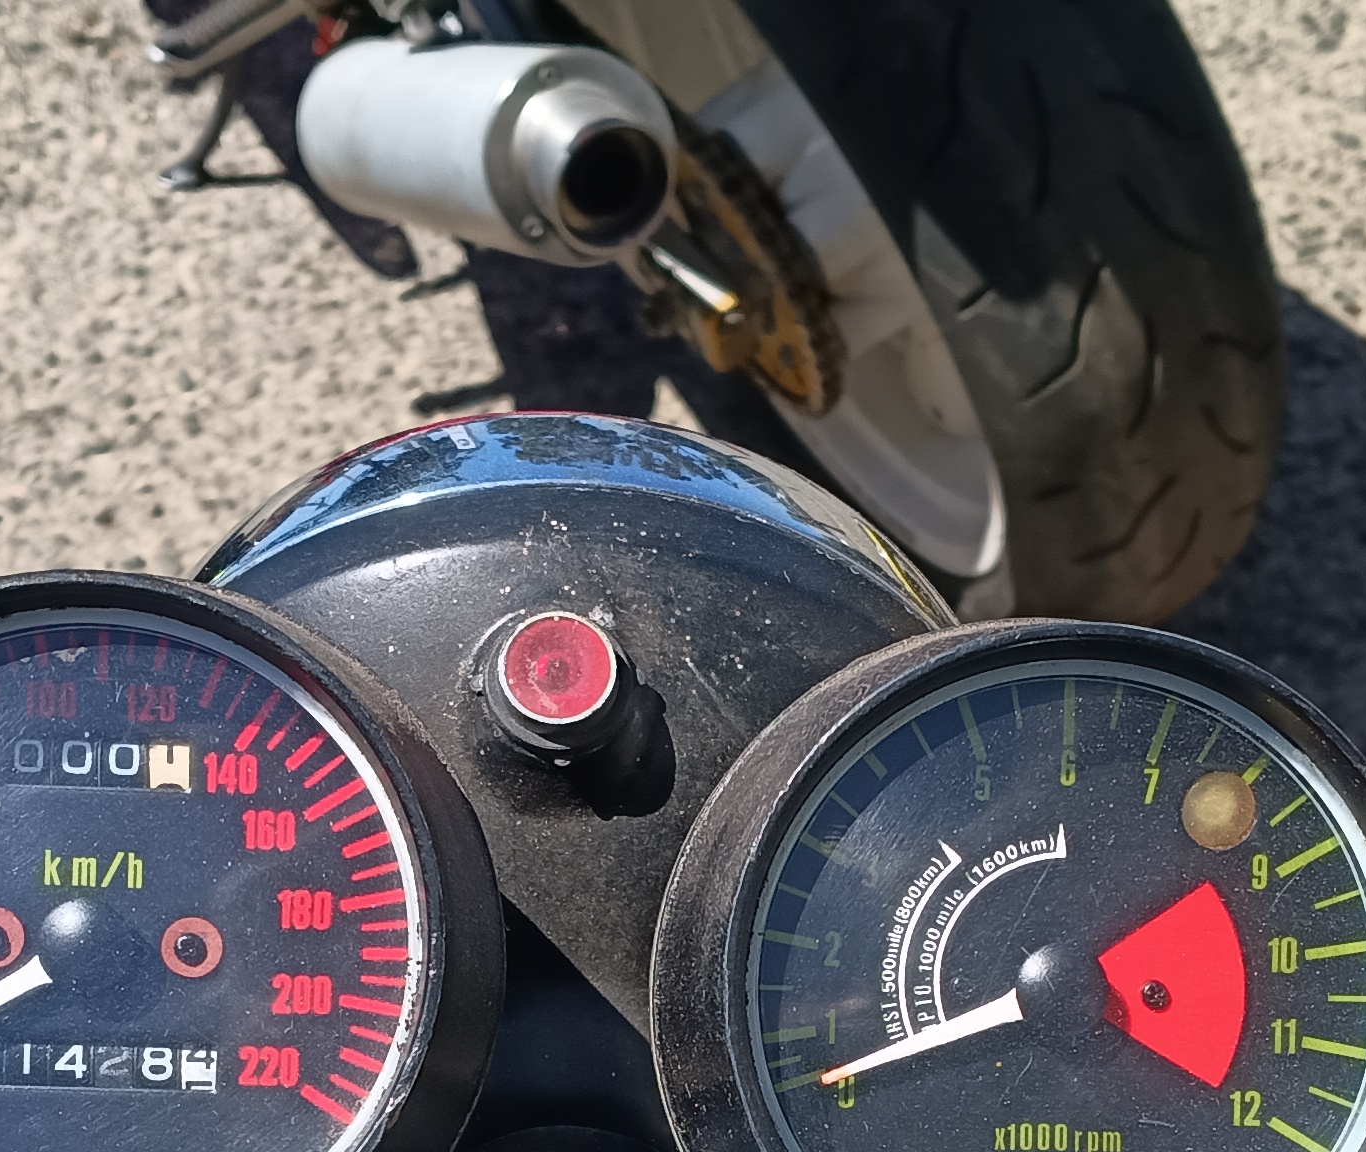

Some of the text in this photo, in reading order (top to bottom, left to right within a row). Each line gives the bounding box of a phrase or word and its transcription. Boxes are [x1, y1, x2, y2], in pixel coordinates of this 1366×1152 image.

[26, 681, 78, 718] 100
[127, 684, 178, 722] 120
[204, 752, 258, 795] 140
[974, 765, 991, 800] 5
[1060, 750, 1076, 786] 6
[1143, 768, 1160, 804] 7
[242, 809, 296, 851] 160
[43, 849, 143, 889] km/h
[1251, 853, 1269, 891] 9
[277, 889, 333, 931] 180
[823, 930, 842, 969] 2
[1267, 936, 1299, 974] 10
[271, 972, 333, 1016] 200
[824, 1008, 836, 1045] 1
[1270, 1018, 1297, 1055] 11
[238, 1045, 301, 1088] 220
[1229, 1090, 1262, 1127] 12
[994, 1122, 1068, 1151] x1000
